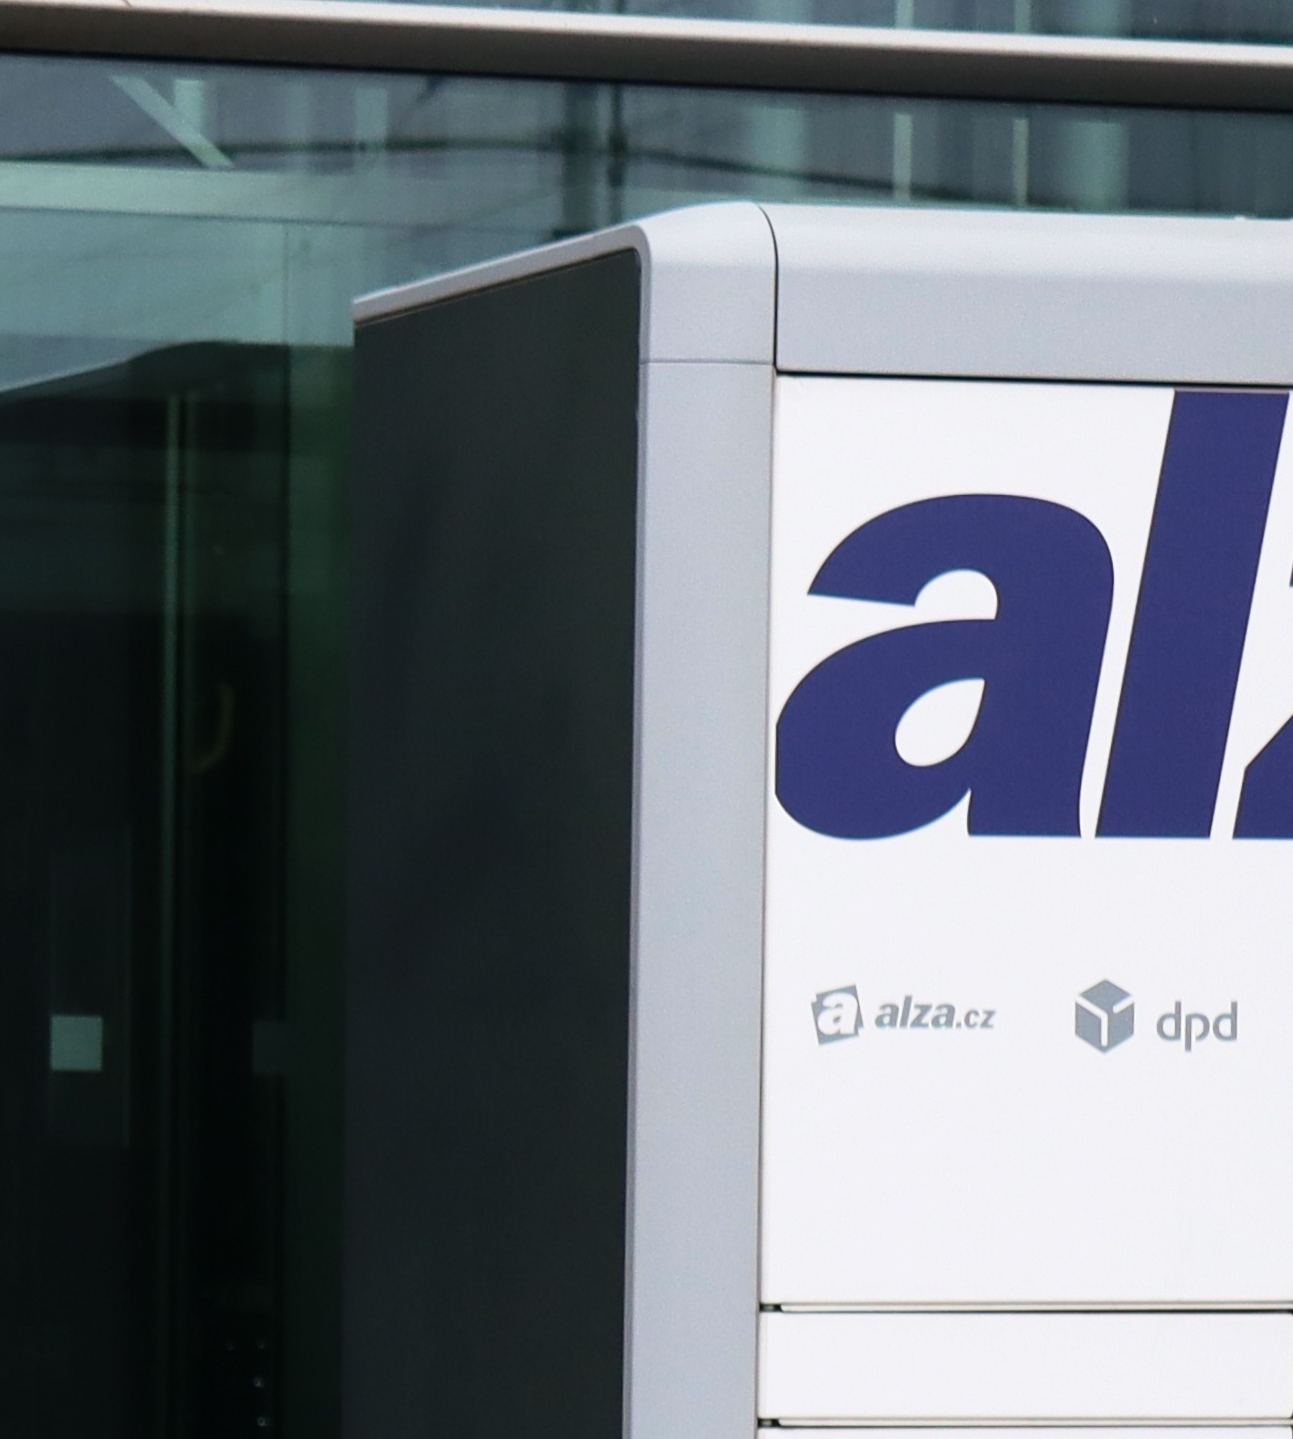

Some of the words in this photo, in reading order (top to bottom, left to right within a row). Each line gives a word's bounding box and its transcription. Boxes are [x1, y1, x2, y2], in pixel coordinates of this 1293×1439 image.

[775, 389, 1293, 841] al
[874, 994, 997, 1030] alza.cz
[1156, 1001, 1239, 1052] dpd
